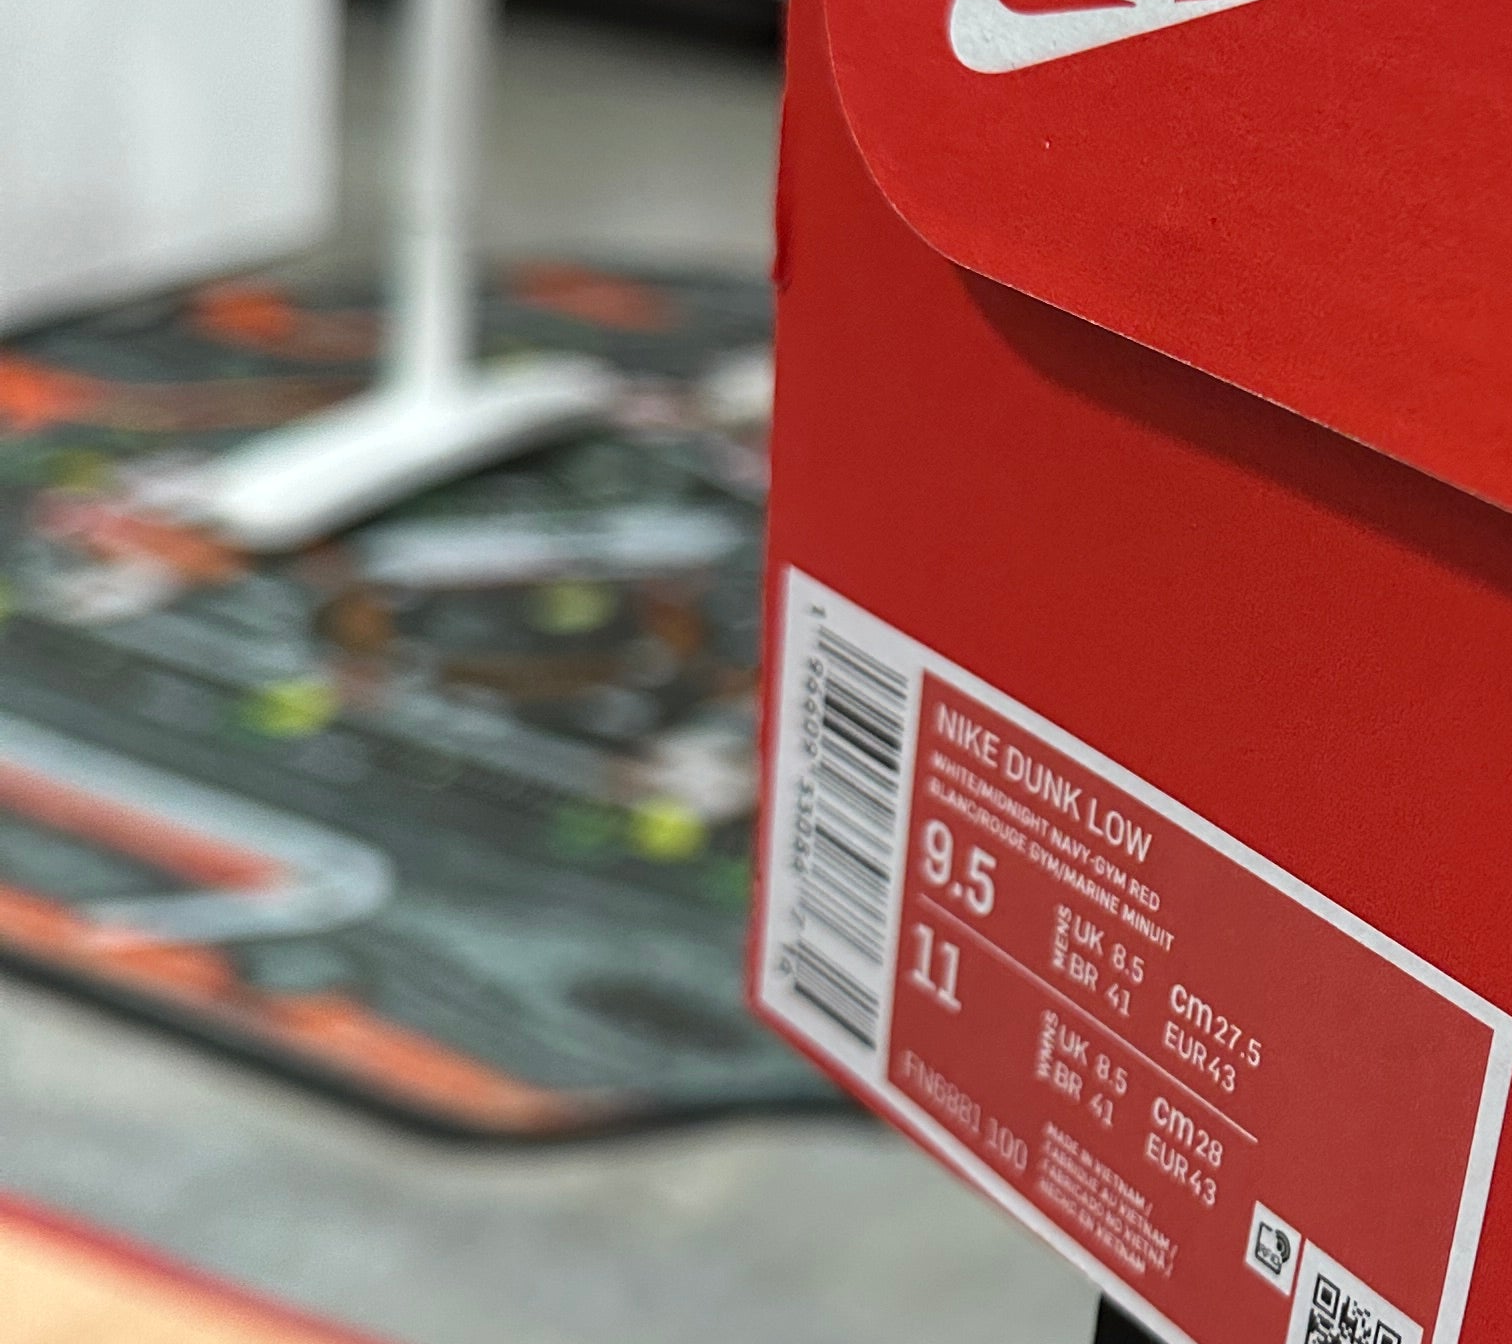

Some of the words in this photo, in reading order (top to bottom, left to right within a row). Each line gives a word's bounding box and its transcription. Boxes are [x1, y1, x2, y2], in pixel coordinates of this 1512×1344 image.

[936, 703, 1000, 768] NIKE
[1005, 745, 1082, 821] DUNK
[1087, 798, 1152, 863] LOW
[923, 819, 997, 917] 9.5
[1029, 841, 1120, 914] GYM/MARINE
[1121, 904, 1174, 951] MINUIT
[1050, 827, 1128, 889] NAVY-GYM
[1129, 878, 1160, 911] RED
[907, 922, 961, 1014] 11
[1068, 953, 1098, 992] BR
[1105, 983, 1130, 1016] 41
[1072, 915, 1104, 955] UK
[1111, 943, 1144, 984] 8.5
[1053, 1060, 1083, 1102] BR
[1089, 1092, 1114, 1128] 41
[1057, 1024, 1090, 1066] UK
[1096, 1053, 1128, 1095] 8.5
[988, 1117, 1028, 1170] 100
